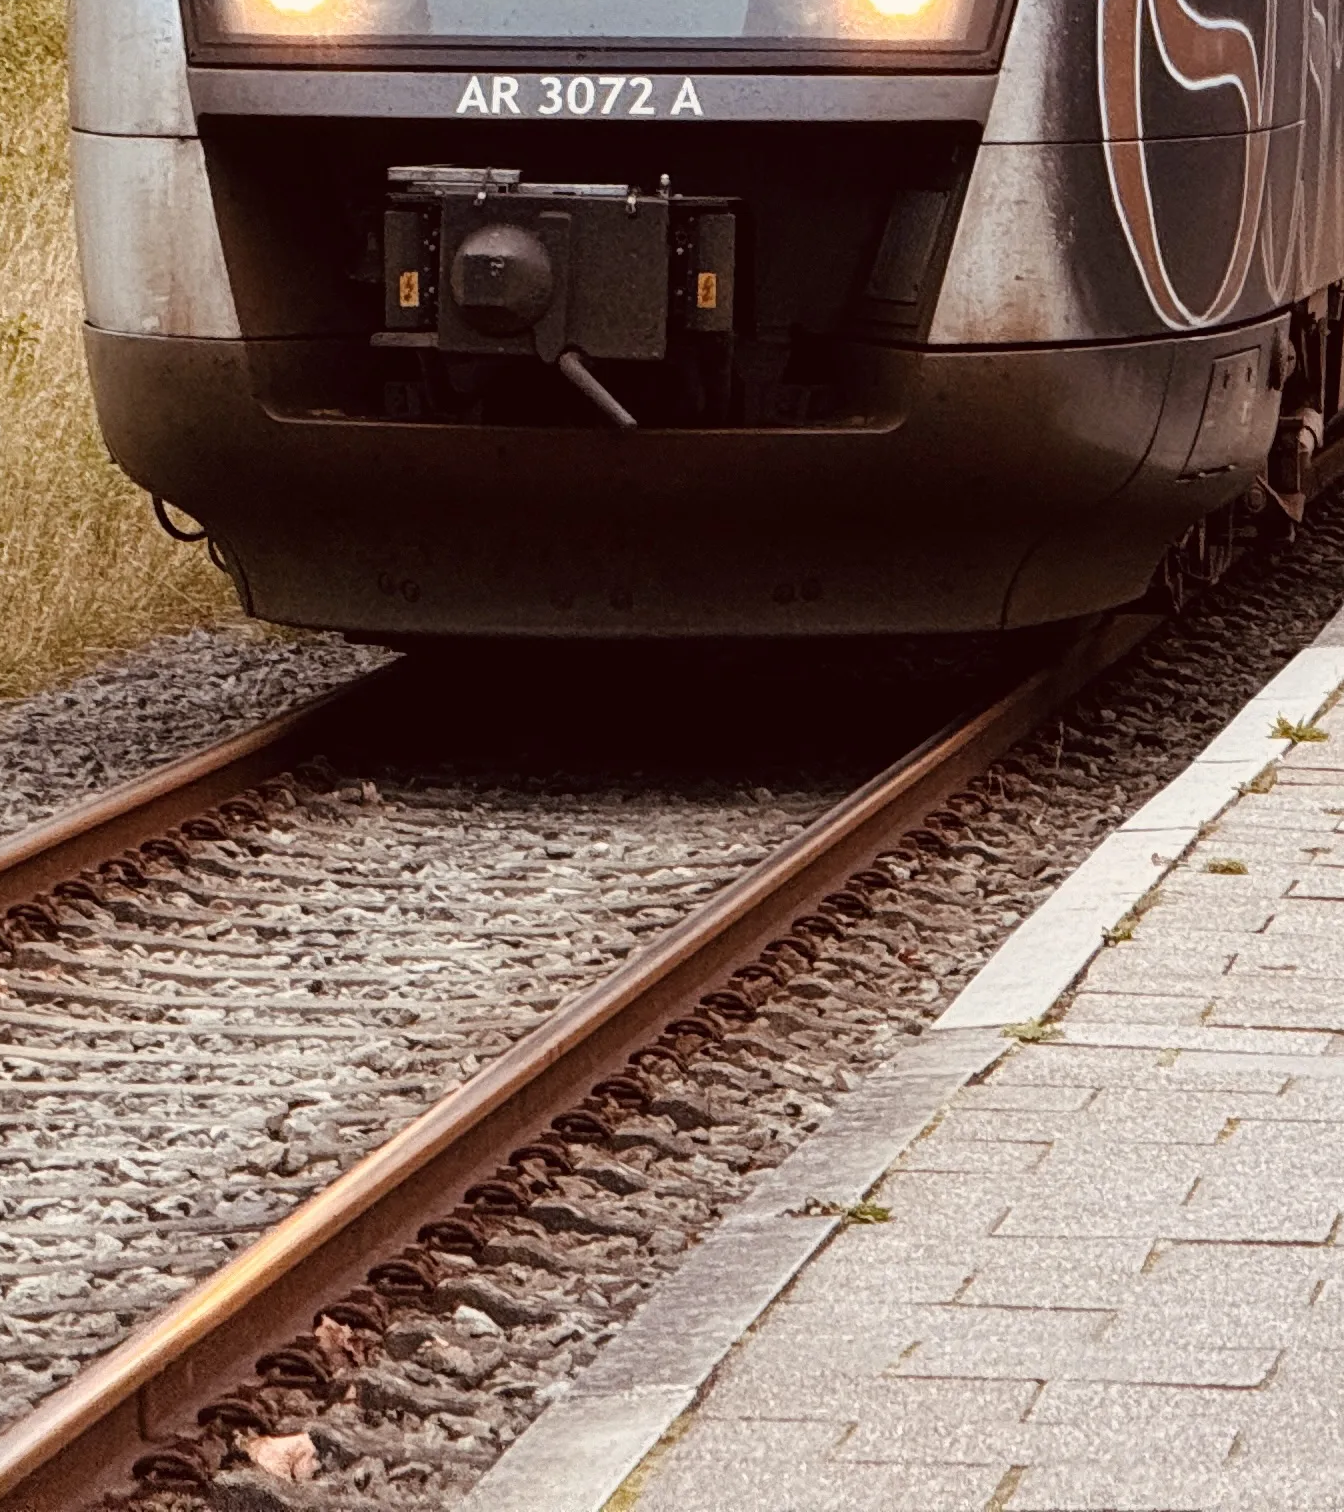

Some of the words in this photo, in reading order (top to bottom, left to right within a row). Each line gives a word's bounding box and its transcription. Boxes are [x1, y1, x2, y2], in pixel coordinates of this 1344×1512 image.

[456, 75, 521, 114] AR
[537, 76, 655, 115] 3072
[670, 76, 704, 116] A
